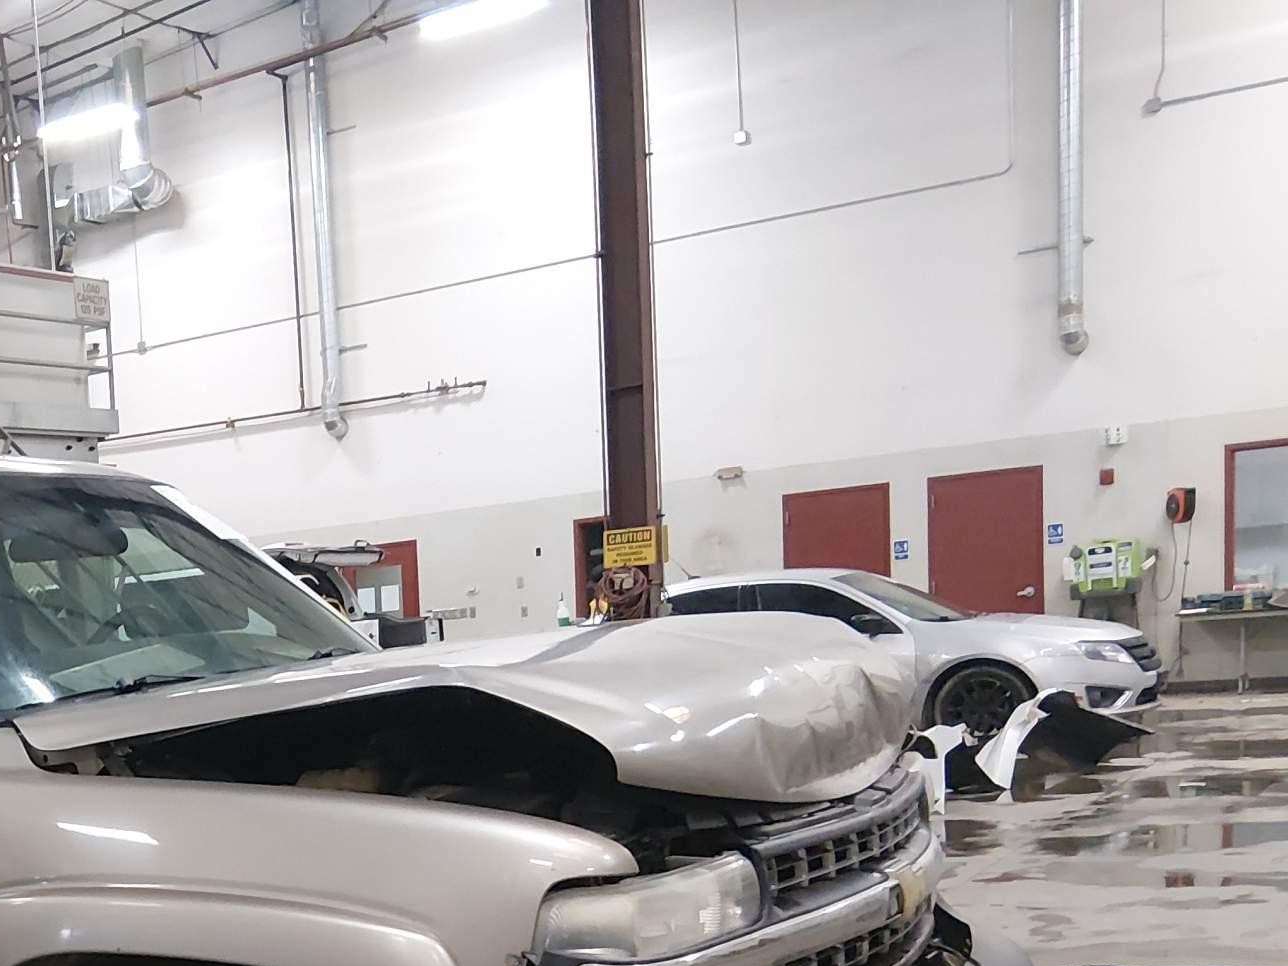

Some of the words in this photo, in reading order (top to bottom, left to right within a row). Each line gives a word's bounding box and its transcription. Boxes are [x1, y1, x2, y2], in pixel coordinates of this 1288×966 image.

[82, 283, 100, 294] LOAD
[77, 292, 107, 305] CAPACITY
[608, 530, 651, 545] CAUTION
